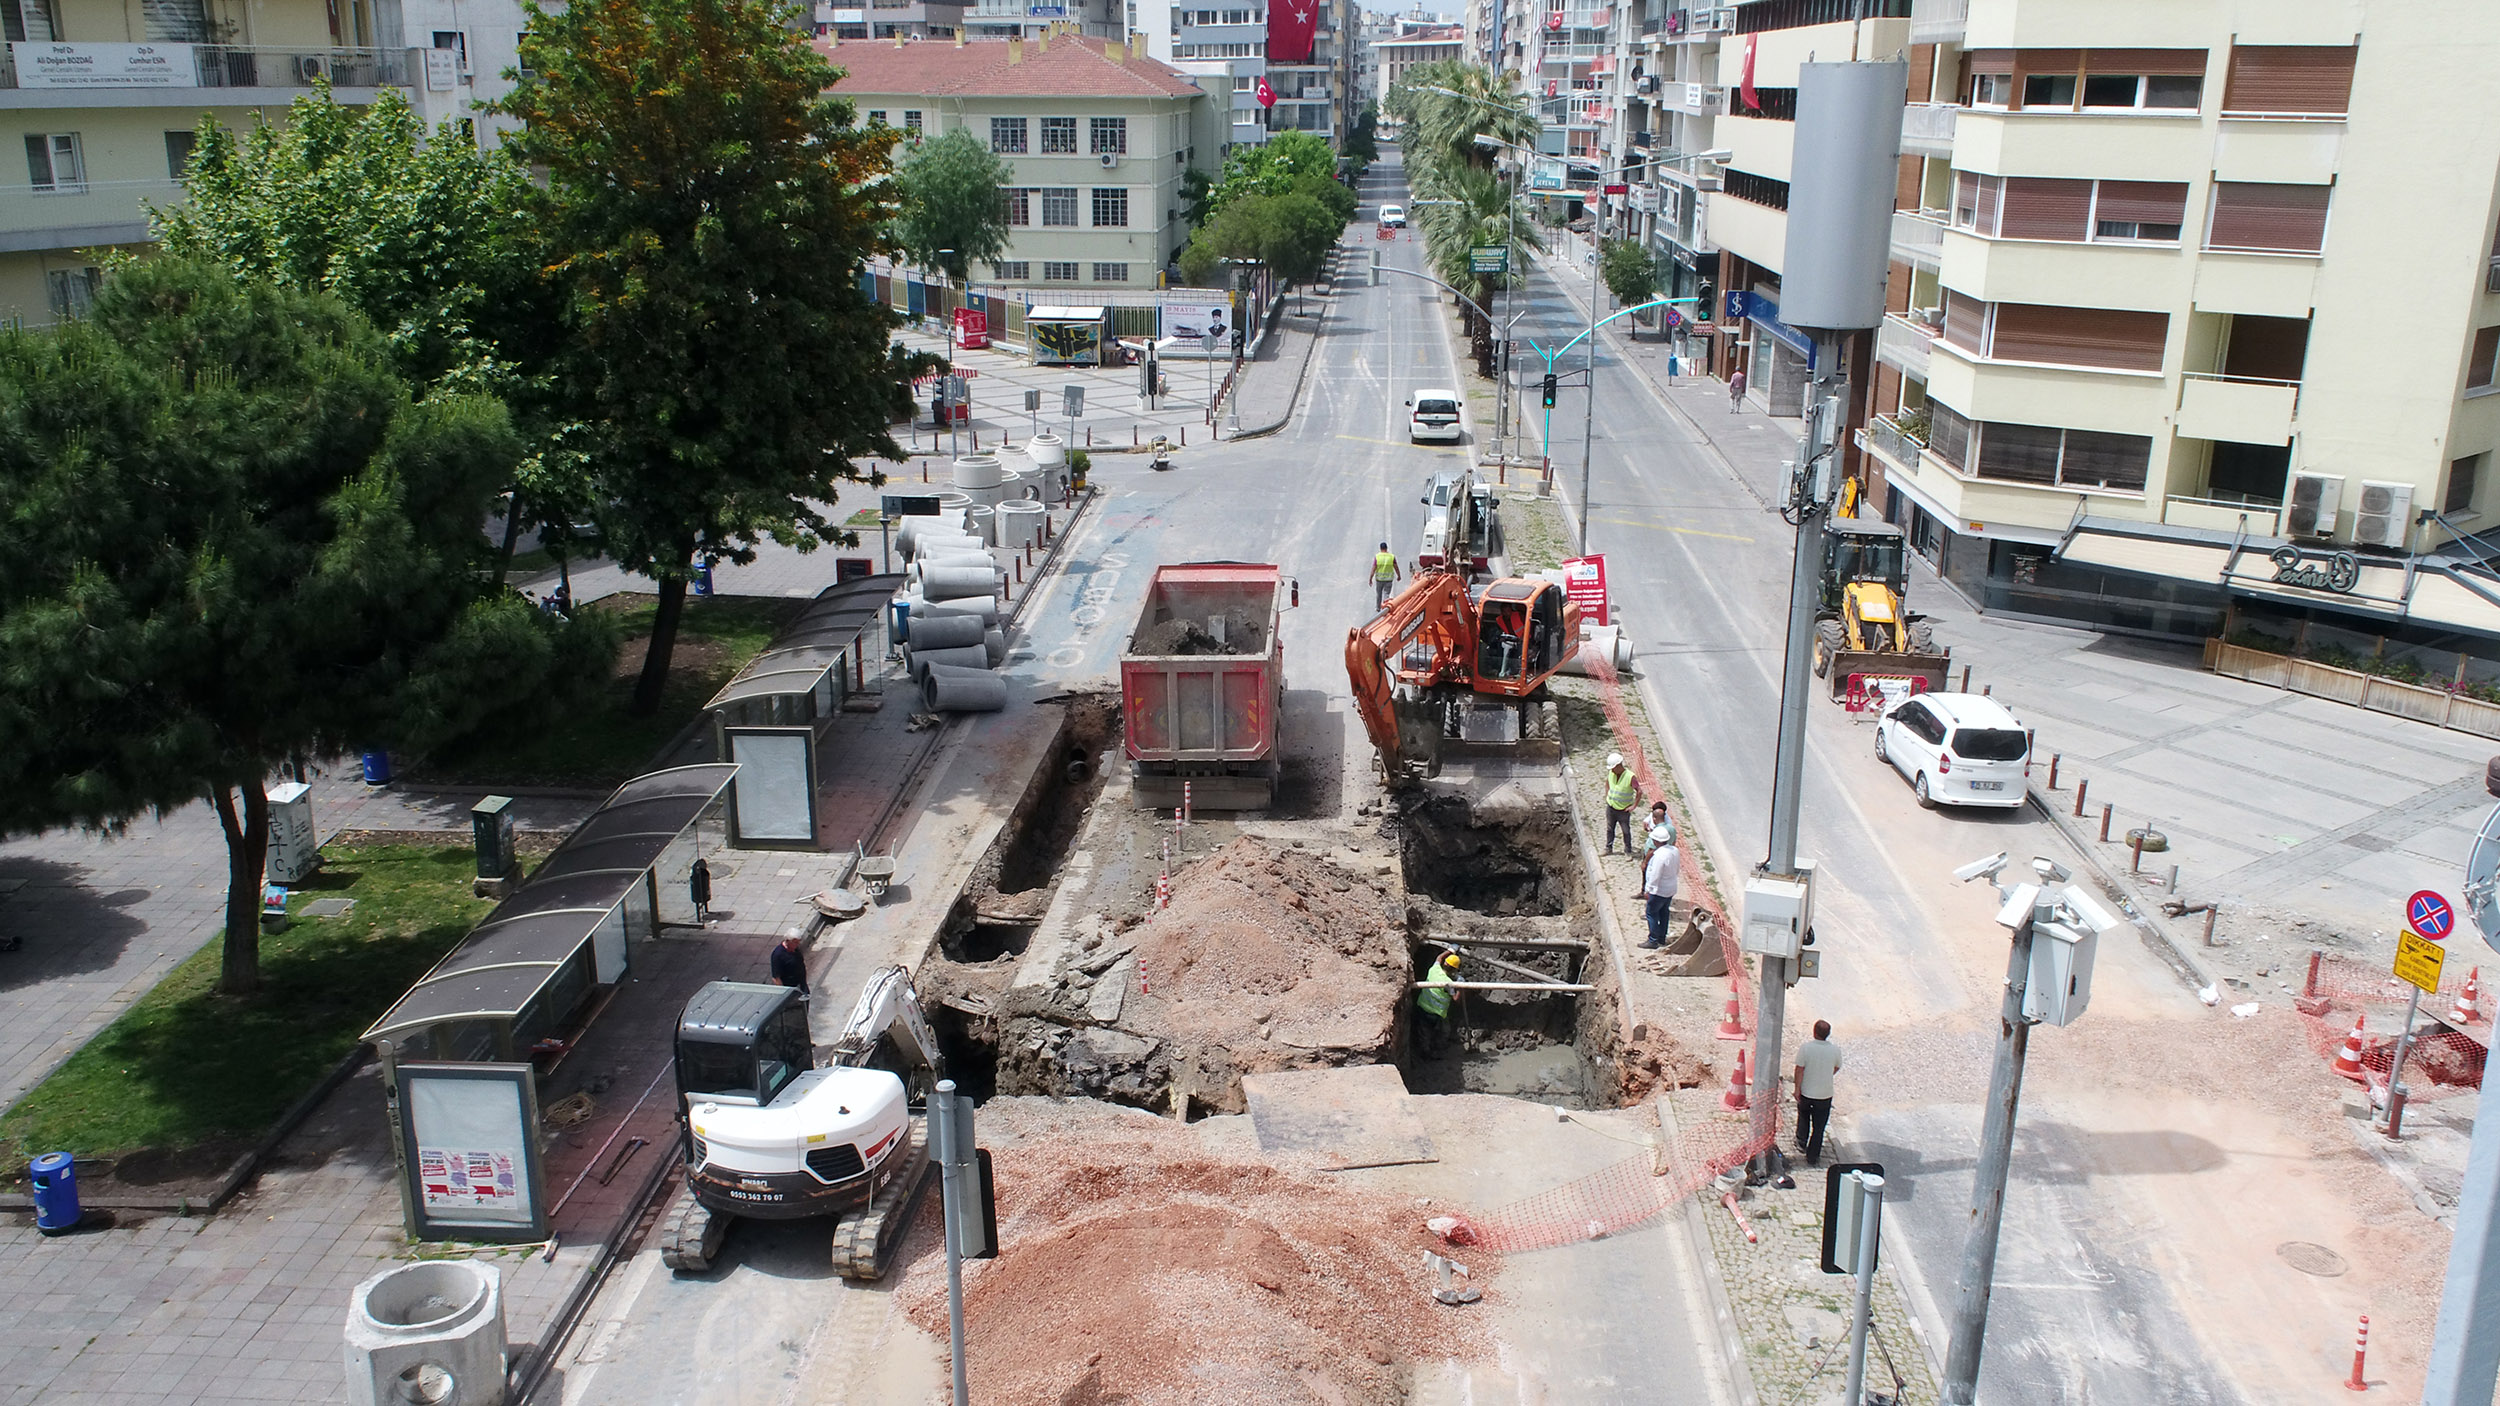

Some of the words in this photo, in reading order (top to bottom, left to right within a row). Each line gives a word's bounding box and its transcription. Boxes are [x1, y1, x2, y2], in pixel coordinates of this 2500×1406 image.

[1471, 248, 1506, 256] SUBWAY
[2407, 935, 2436, 954] DİKKAT
[730, 1190, 746, 1199] 0553
